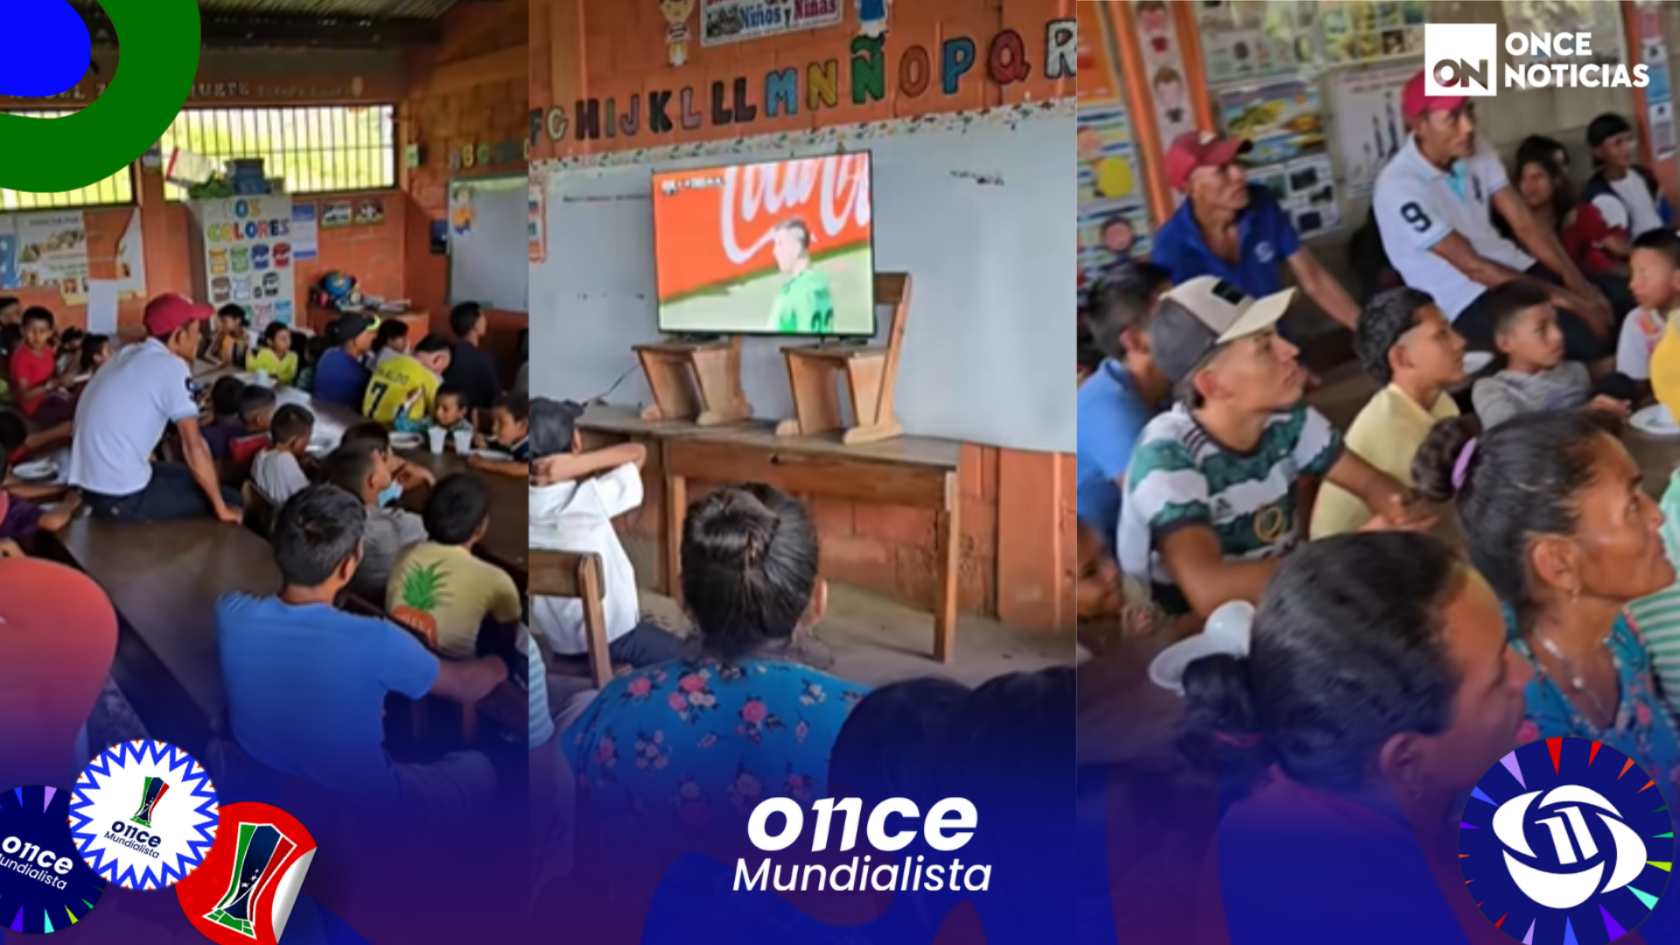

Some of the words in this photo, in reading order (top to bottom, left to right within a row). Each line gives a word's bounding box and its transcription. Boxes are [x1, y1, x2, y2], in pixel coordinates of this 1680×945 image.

[741, 5, 781, 28] Niños
[575, 98, 600, 141] H
[606, 98, 616, 138] I
[619, 93, 641, 136] J
[649, 90, 673, 134] K
[680, 86, 703, 130] L
[711, 77, 758, 126] LL
[765, 67, 799, 118] M
[806, 58, 839, 111] N
[851, 30, 888, 105] Ñ
[899, 44, 931, 98] O
[941, 36, 976, 95] P
[988, 29, 1031, 85] Q
[1044, 18, 1076, 80] R
[208, 219, 290, 243] COLORES
[1400, 201, 1432, 233] 9
[369, 381, 390, 419] 7
